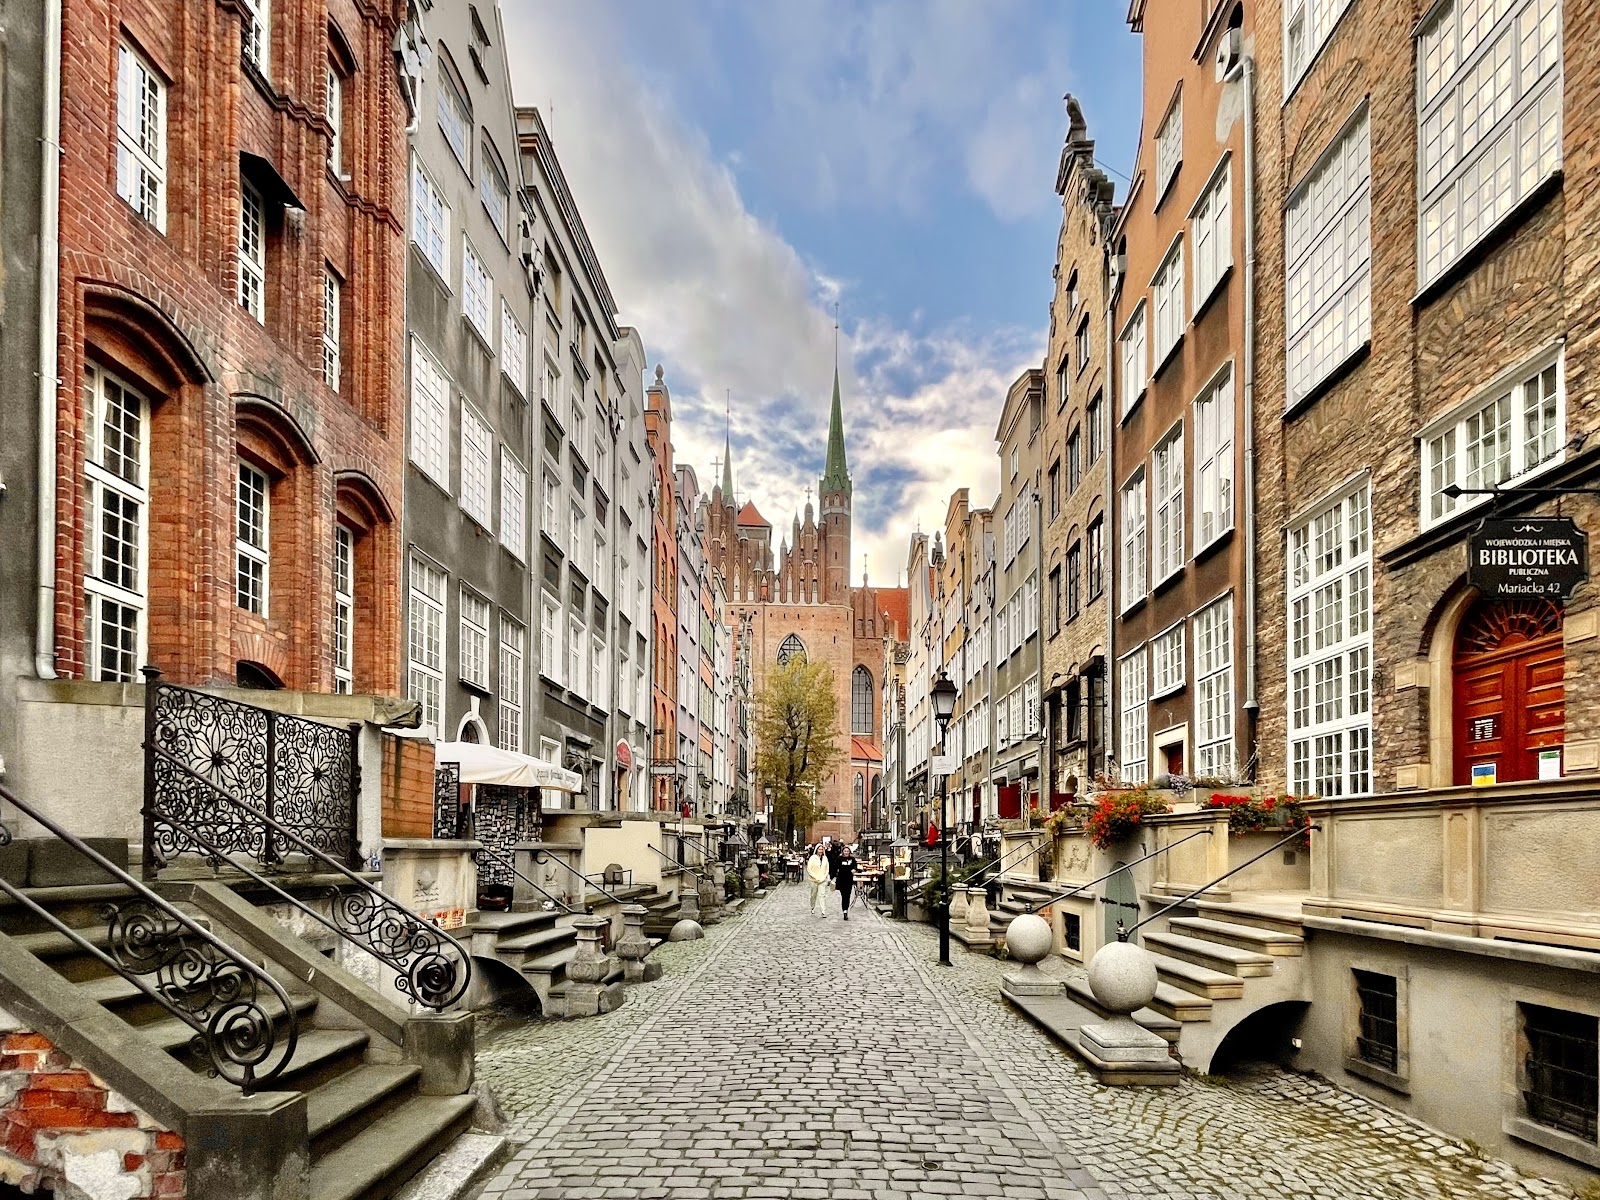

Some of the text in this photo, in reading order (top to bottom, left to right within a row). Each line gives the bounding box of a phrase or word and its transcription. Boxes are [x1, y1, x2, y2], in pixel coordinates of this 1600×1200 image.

[1485, 537, 1537, 547] WOJEWÓDZKA
[1543, 539, 1571, 547] MIEJSKA
[1480, 549, 1578, 565] BIBLIOTEKA
[1498, 582, 1560, 593] Mariacka 42
